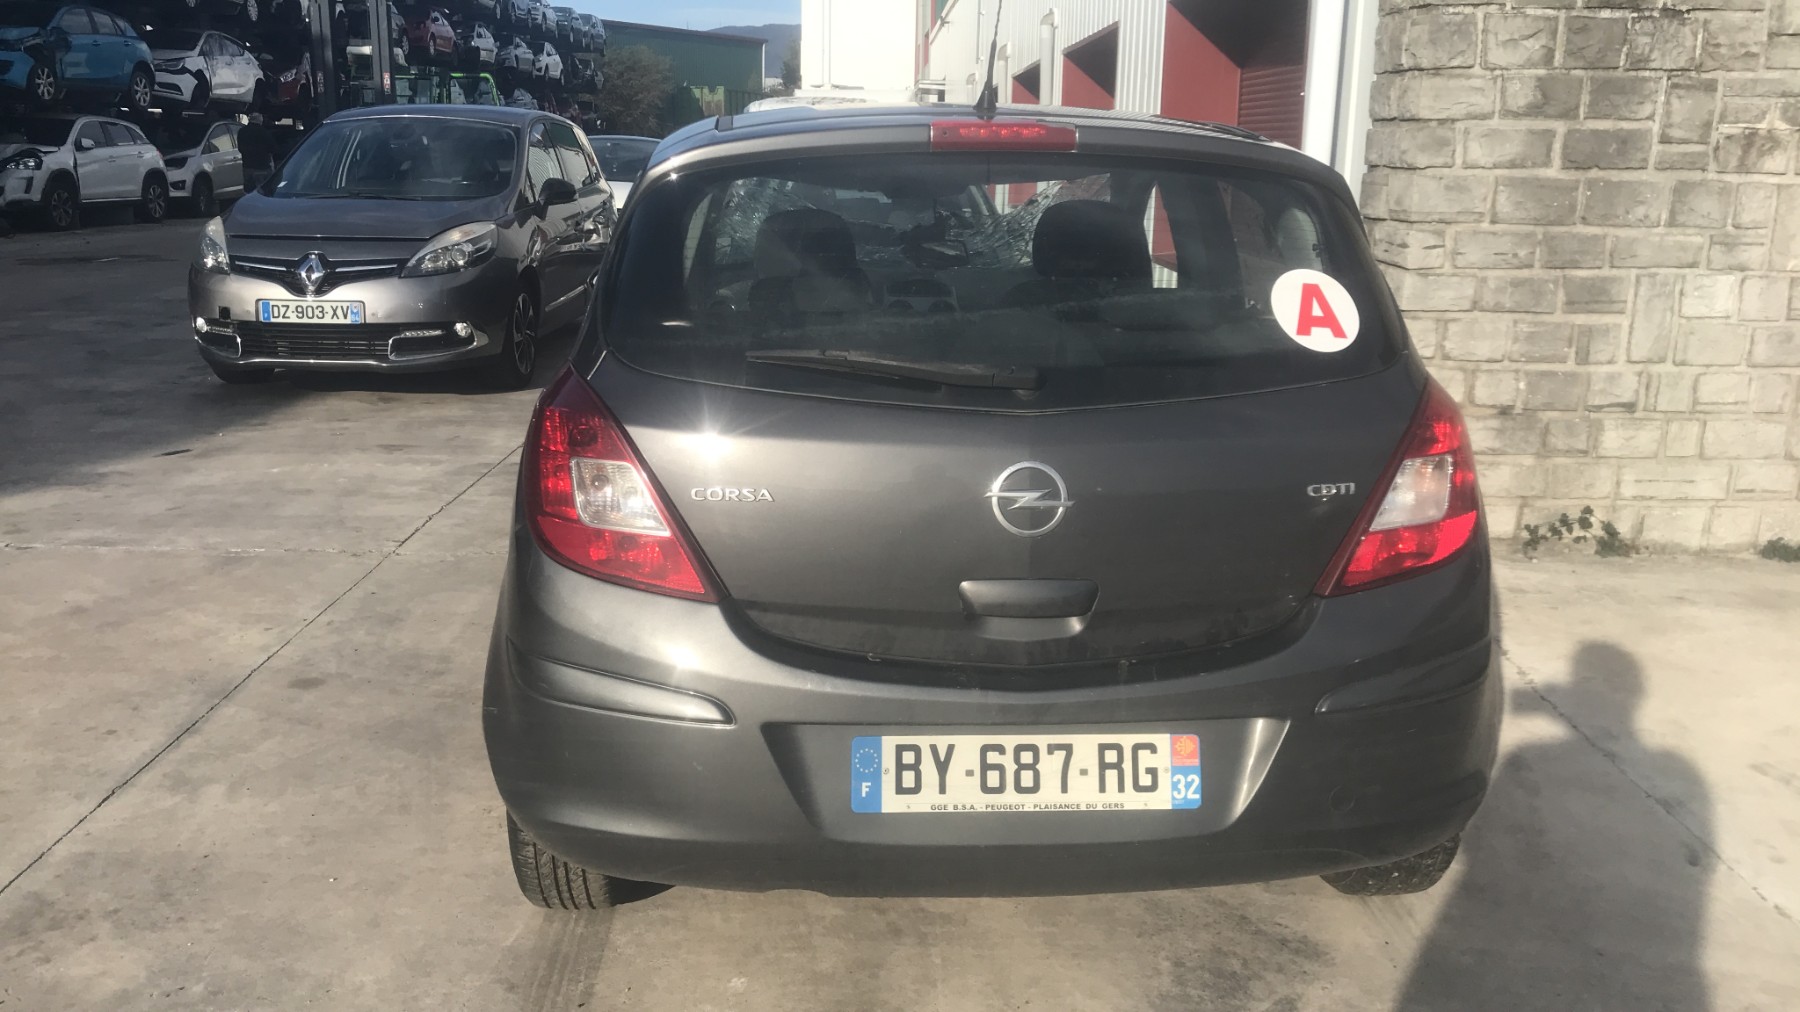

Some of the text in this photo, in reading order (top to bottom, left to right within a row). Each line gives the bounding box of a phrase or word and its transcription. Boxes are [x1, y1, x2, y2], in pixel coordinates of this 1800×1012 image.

[271, 305, 349, 320] DZ-903-XV
[1296, 283, 1348, 339] A
[690, 487, 775, 502] CORSA
[861, 742, 1200, 799] F BY-687-RG 32
[985, 803, 1026, 811] PEUGEOT
